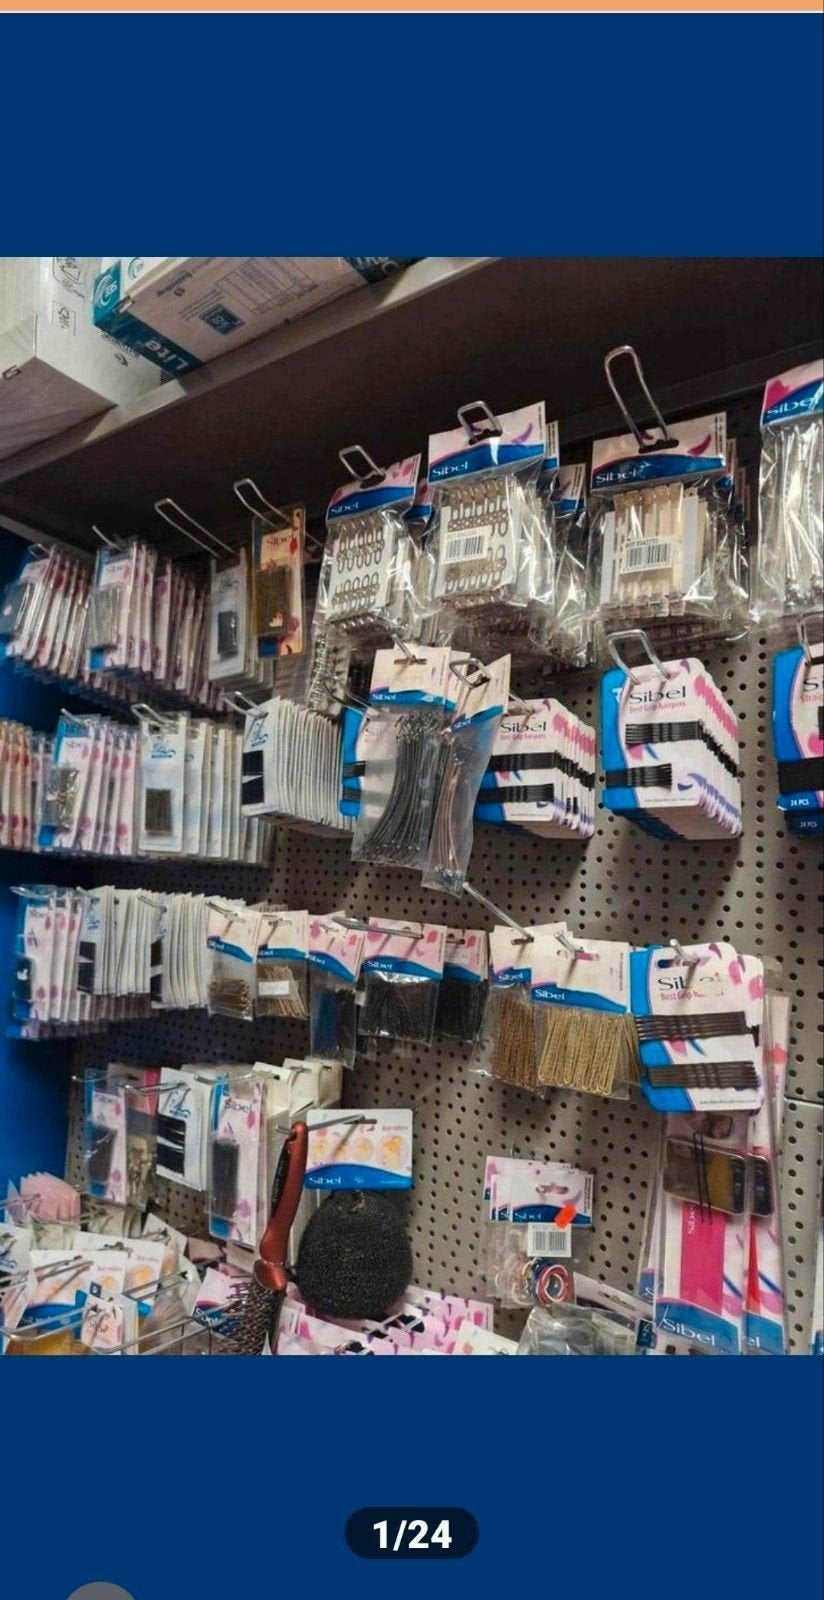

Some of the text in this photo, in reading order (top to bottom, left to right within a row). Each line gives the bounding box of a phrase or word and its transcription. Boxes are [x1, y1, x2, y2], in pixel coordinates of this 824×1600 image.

[432, 461, 468, 477] Sibel
[596, 469, 636, 484] Sibel
[630, 686, 686, 705] Sibel
[501, 721, 546, 733] Sibel
[535, 988, 564, 1000] Sibel
[662, 1318, 715, 1346] Sibel
